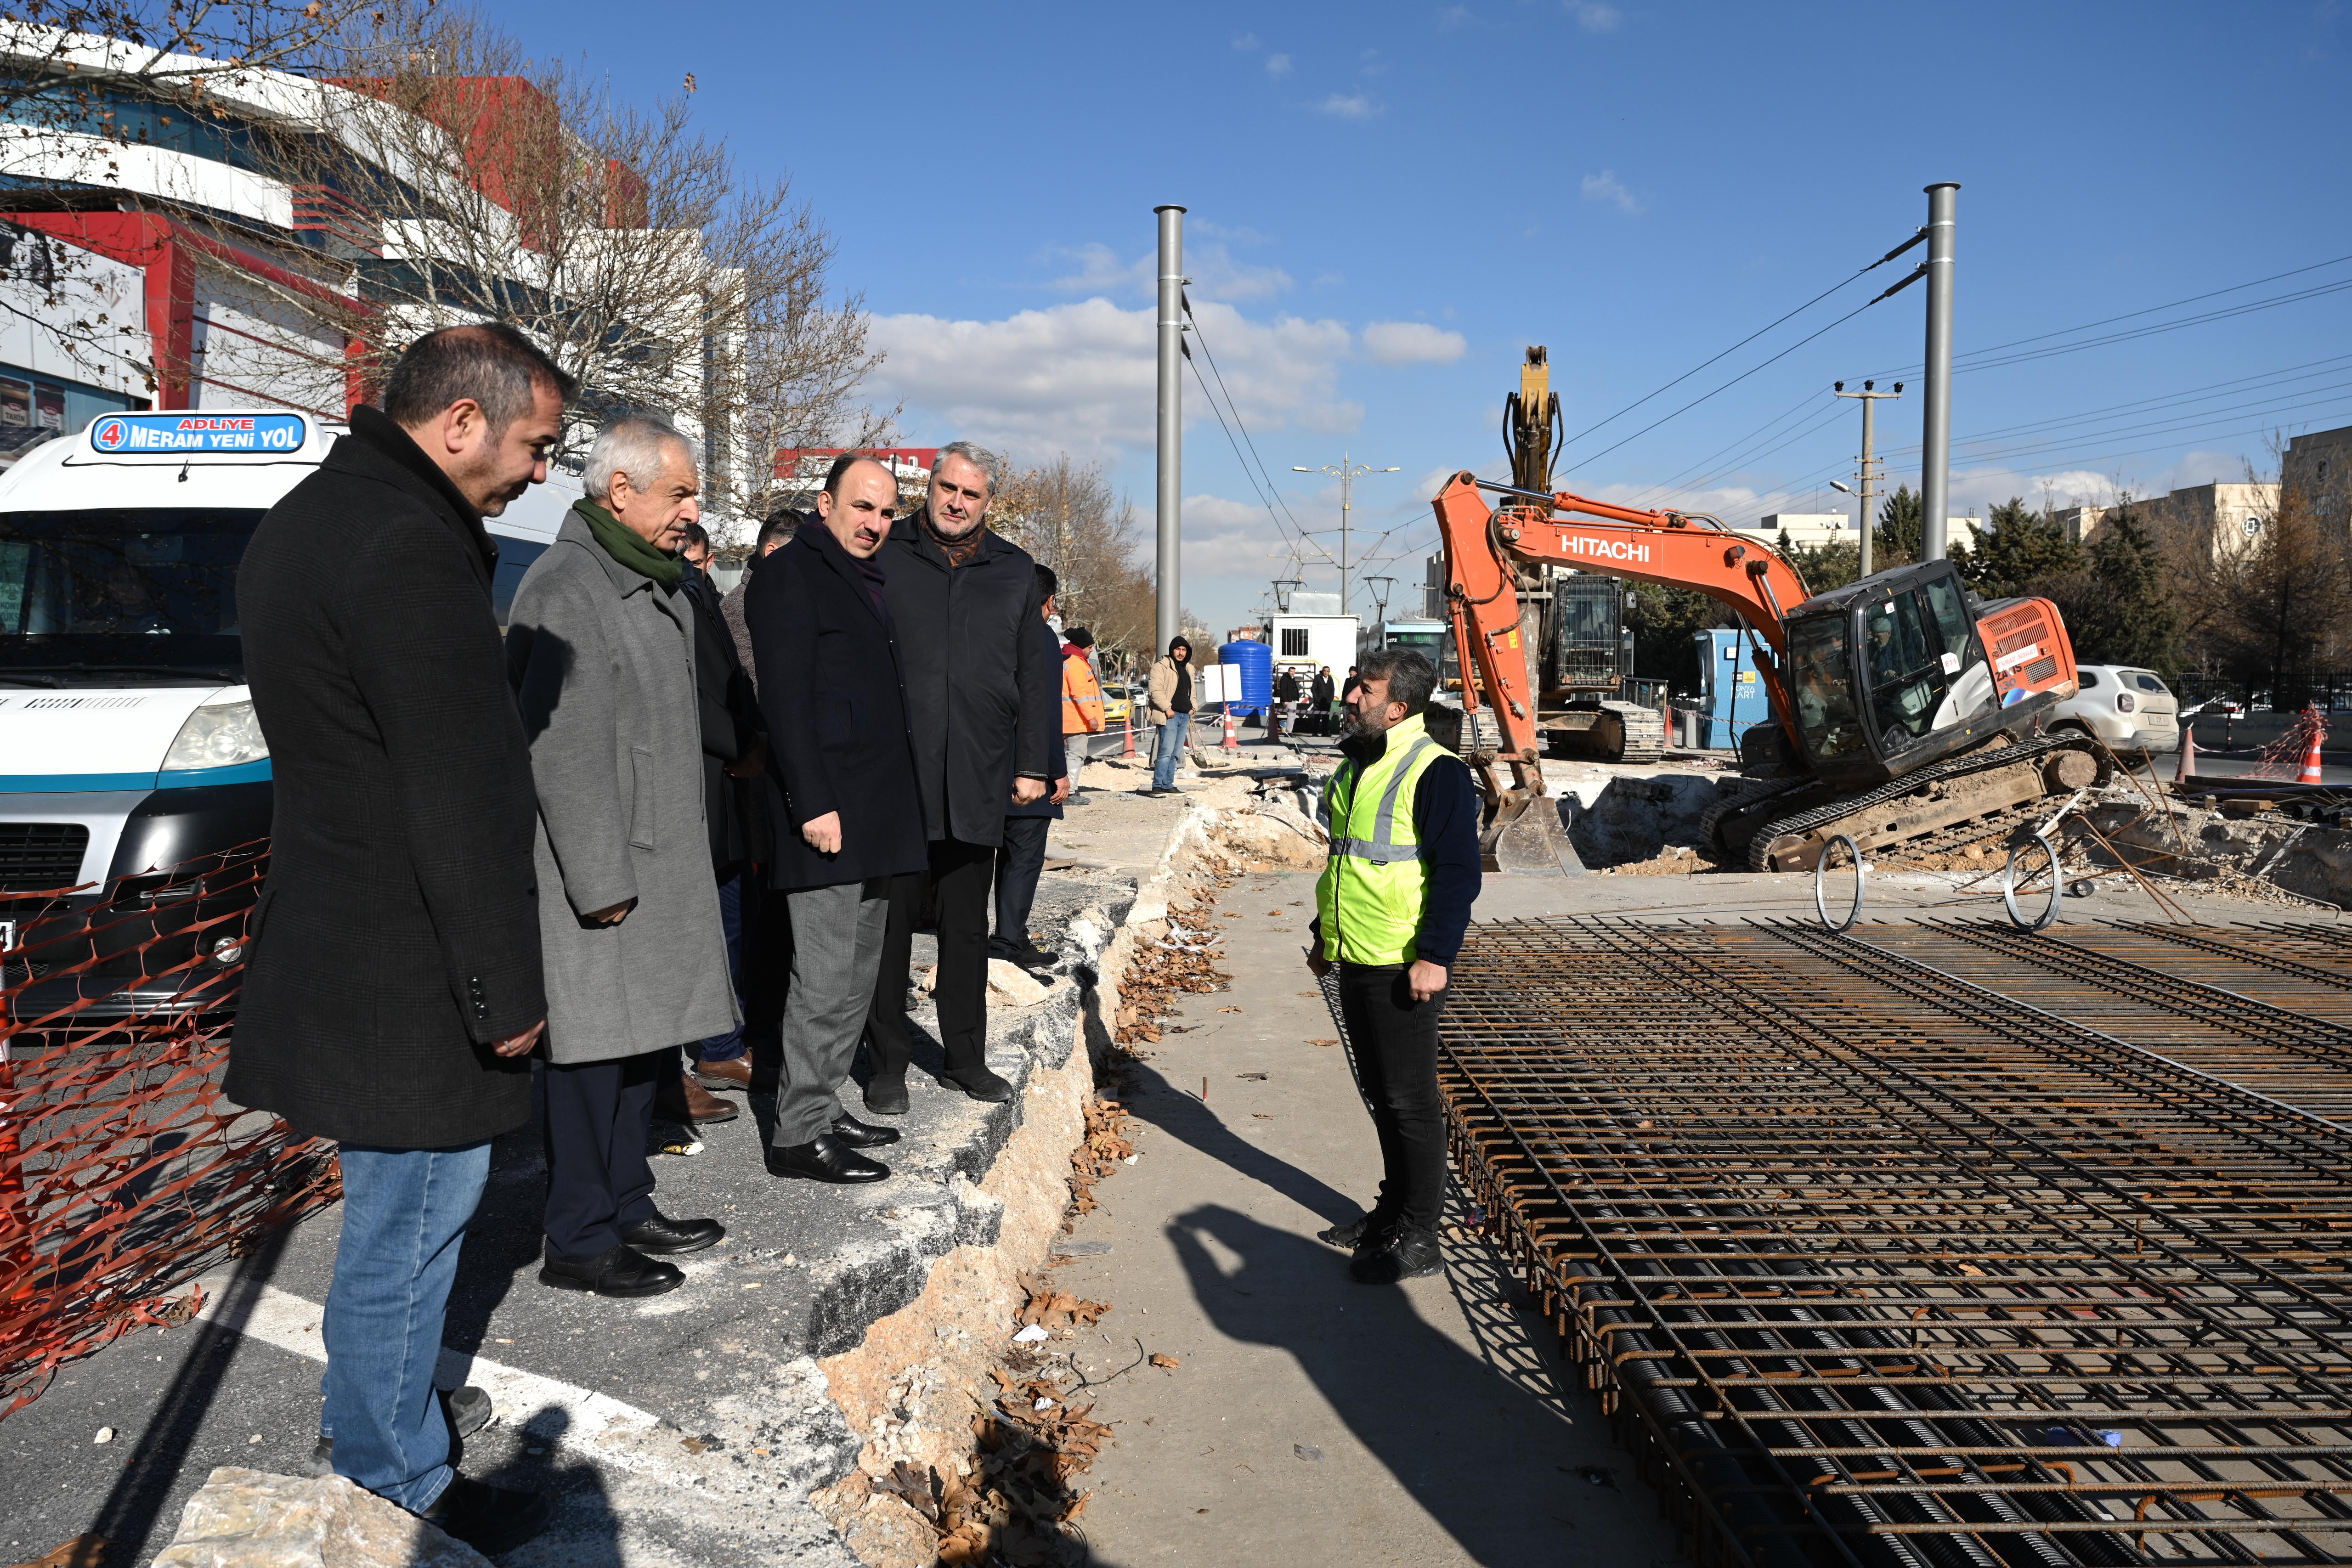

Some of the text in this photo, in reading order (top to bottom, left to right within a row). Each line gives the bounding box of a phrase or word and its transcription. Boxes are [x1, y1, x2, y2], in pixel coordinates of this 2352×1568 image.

[101, 423, 121, 446] 4
[130, 425, 204, 447] MERAM
[260, 426, 298, 447] YOL
[1561, 535, 1649, 563] HITACHI
[1945, 658, 1957, 667] E11
[1999, 677, 2017, 691] 130
